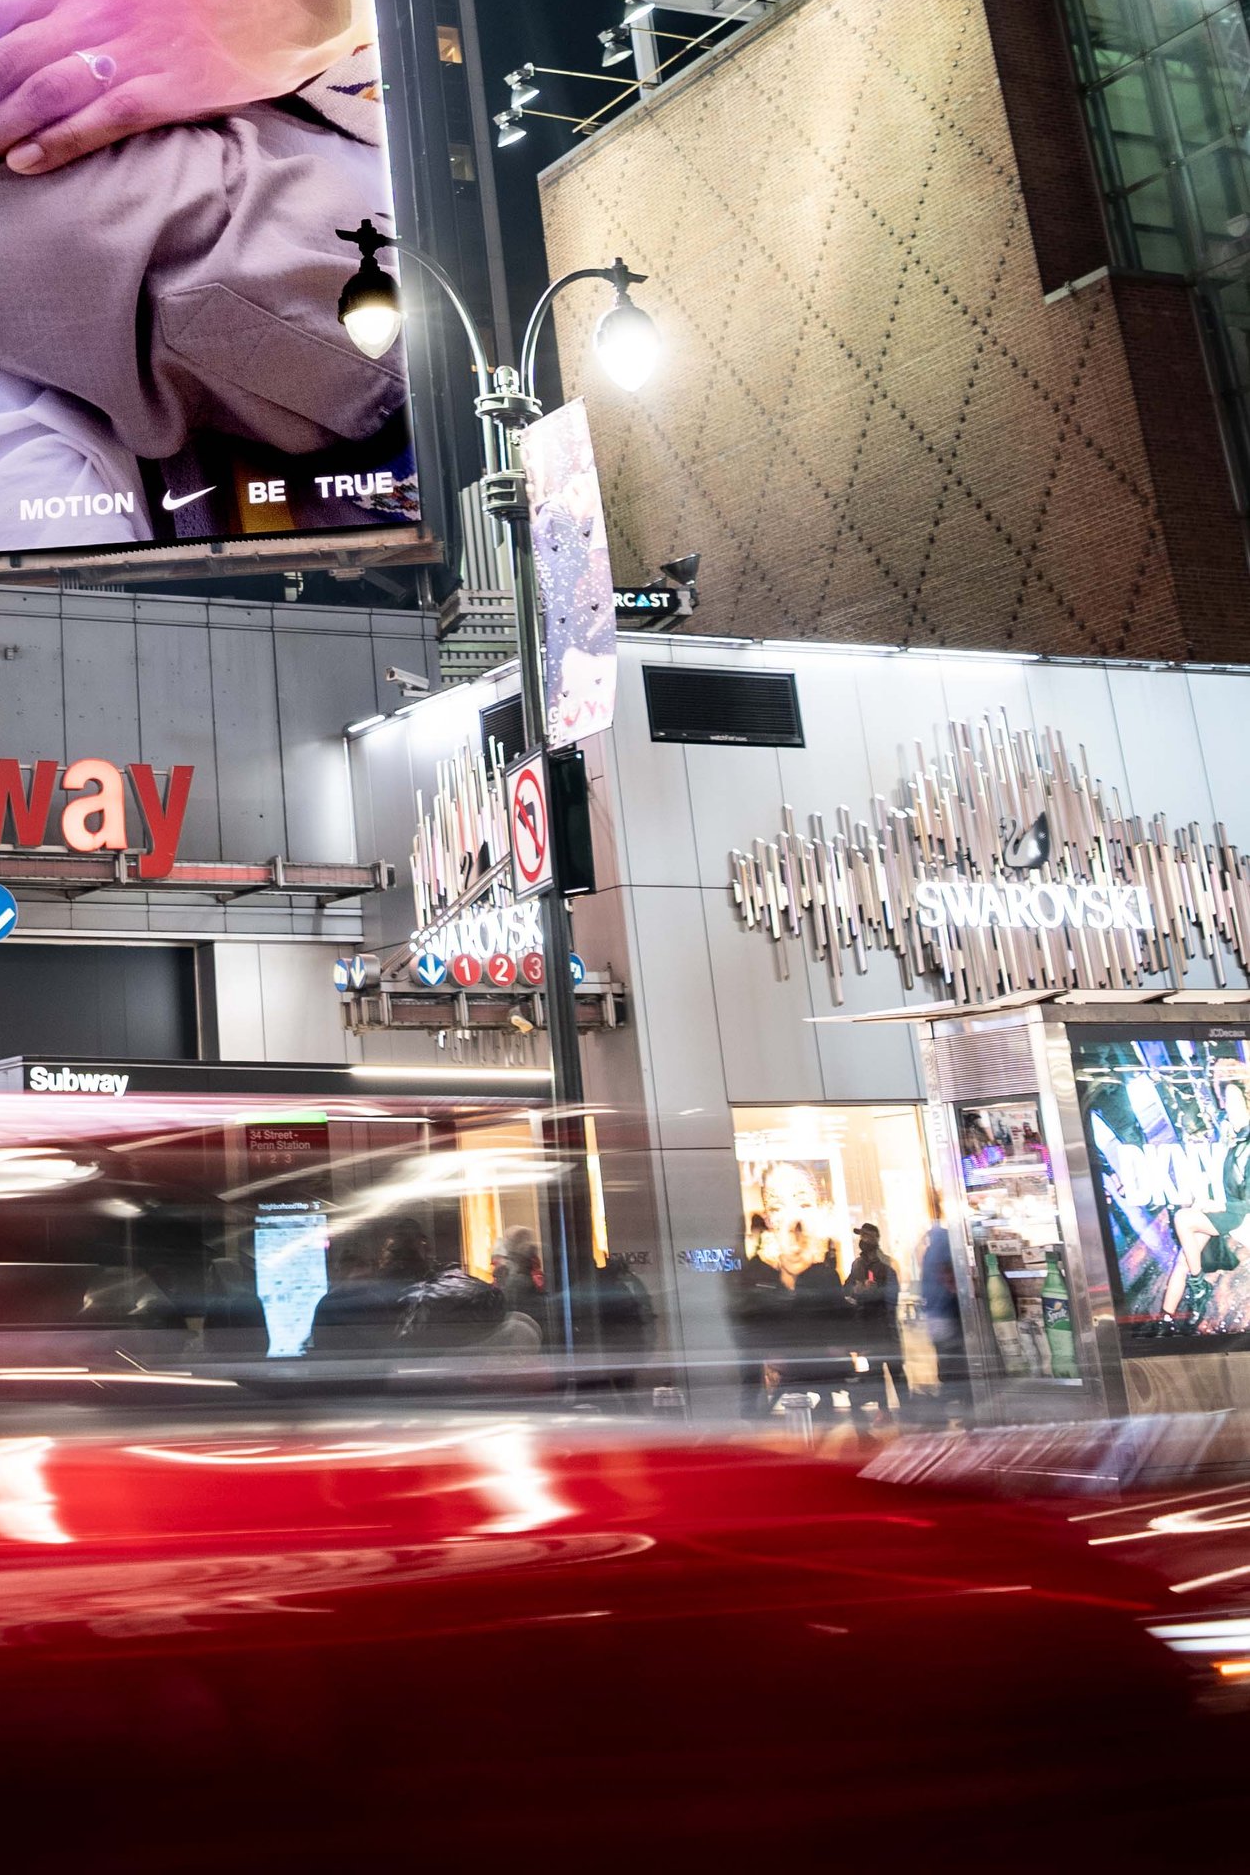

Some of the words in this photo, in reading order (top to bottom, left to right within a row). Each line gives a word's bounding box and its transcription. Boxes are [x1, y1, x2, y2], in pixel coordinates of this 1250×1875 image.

[20, 491, 135, 521] MOTION
[247, 480, 286, 504] BE
[314, 472, 393, 498] TRUE
[916, 881, 1154, 930] SWAROVSKI
[460, 957, 472, 981] 1
[494, 957, 509, 982] 2
[529, 956, 542, 980] 3
[30, 1066, 130, 1097] Subway
[250, 1131, 261, 1140] 34
[250, 1140, 275, 1150] Penn
[276, 1140, 310, 1150] Station
